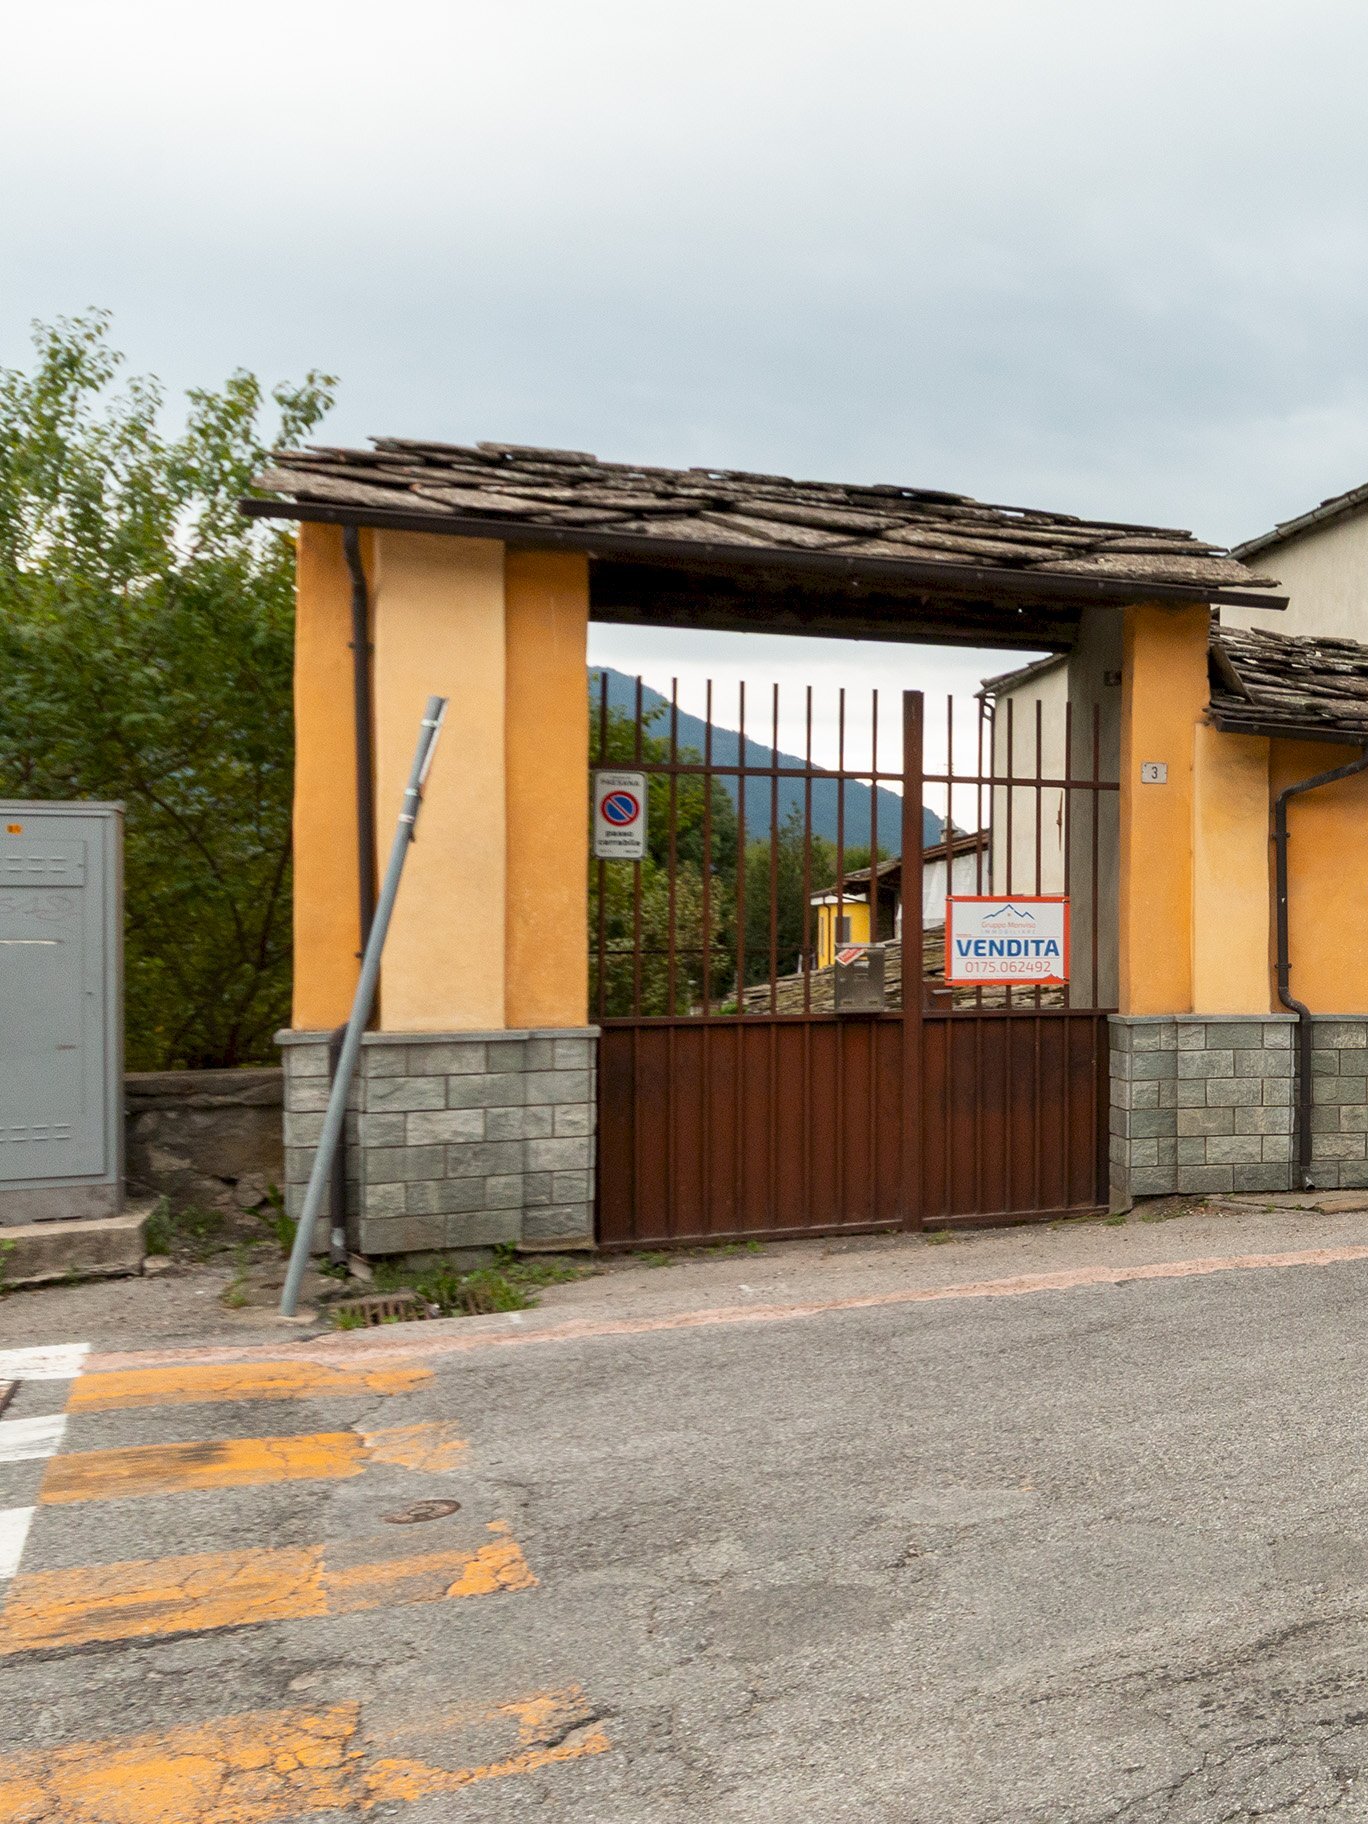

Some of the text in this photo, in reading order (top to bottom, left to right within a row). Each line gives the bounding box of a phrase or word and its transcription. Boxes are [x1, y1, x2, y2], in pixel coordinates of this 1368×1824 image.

[1151, 766, 1158, 779] 3
[981, 921, 1006, 930] Gruppo
[956, 939, 1060, 957] VENDITA
[965, 961, 1051, 973] 0175.062492
